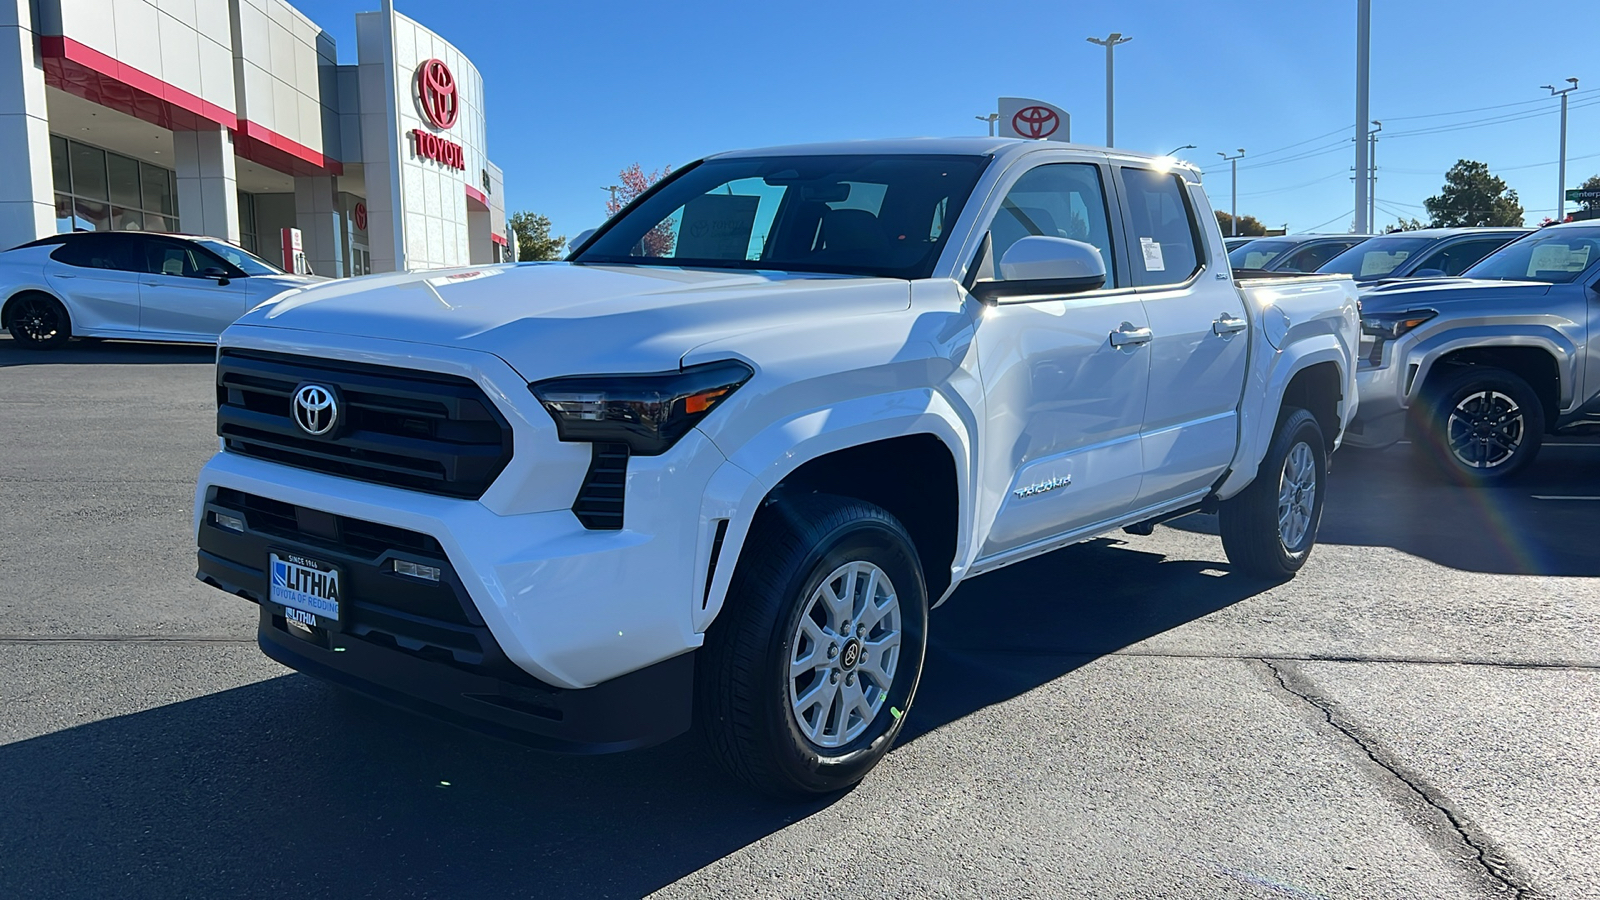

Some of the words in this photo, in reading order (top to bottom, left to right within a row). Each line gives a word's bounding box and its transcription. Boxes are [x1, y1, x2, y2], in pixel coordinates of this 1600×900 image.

[412, 129, 465, 171] TOYOTA
[288, 555, 305, 566] SINCE
[305, 559, 318, 569] 1946
[286, 564, 340, 602] LITHIA
[272, 585, 296, 601] TOYOTA
[297, 594, 307, 604] OF
[308, 597, 339, 613] REDDING
[292, 608, 317, 627] LITHIA
